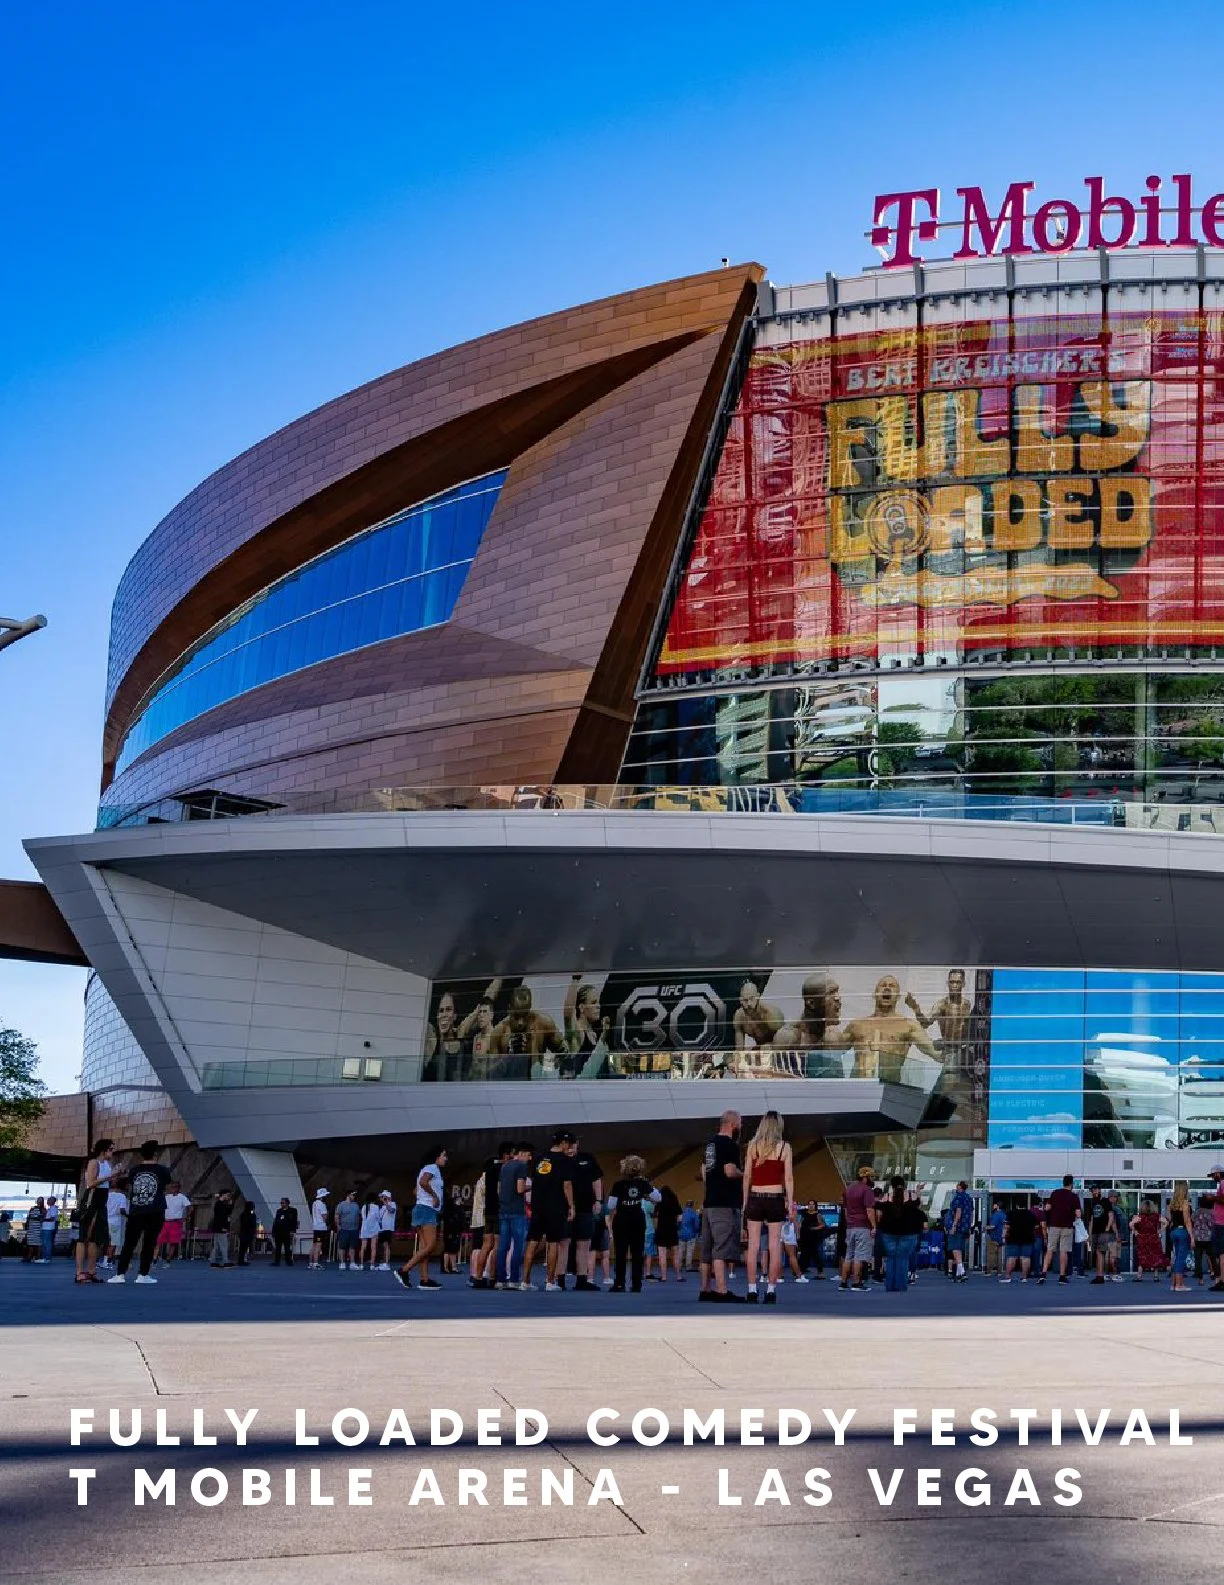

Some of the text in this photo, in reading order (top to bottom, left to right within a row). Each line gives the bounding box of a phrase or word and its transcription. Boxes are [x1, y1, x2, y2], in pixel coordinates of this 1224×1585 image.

[846, 361, 918, 391] BERT
[825, 380, 1152, 488] FULLY
[660, 984, 683, 996] UFC
